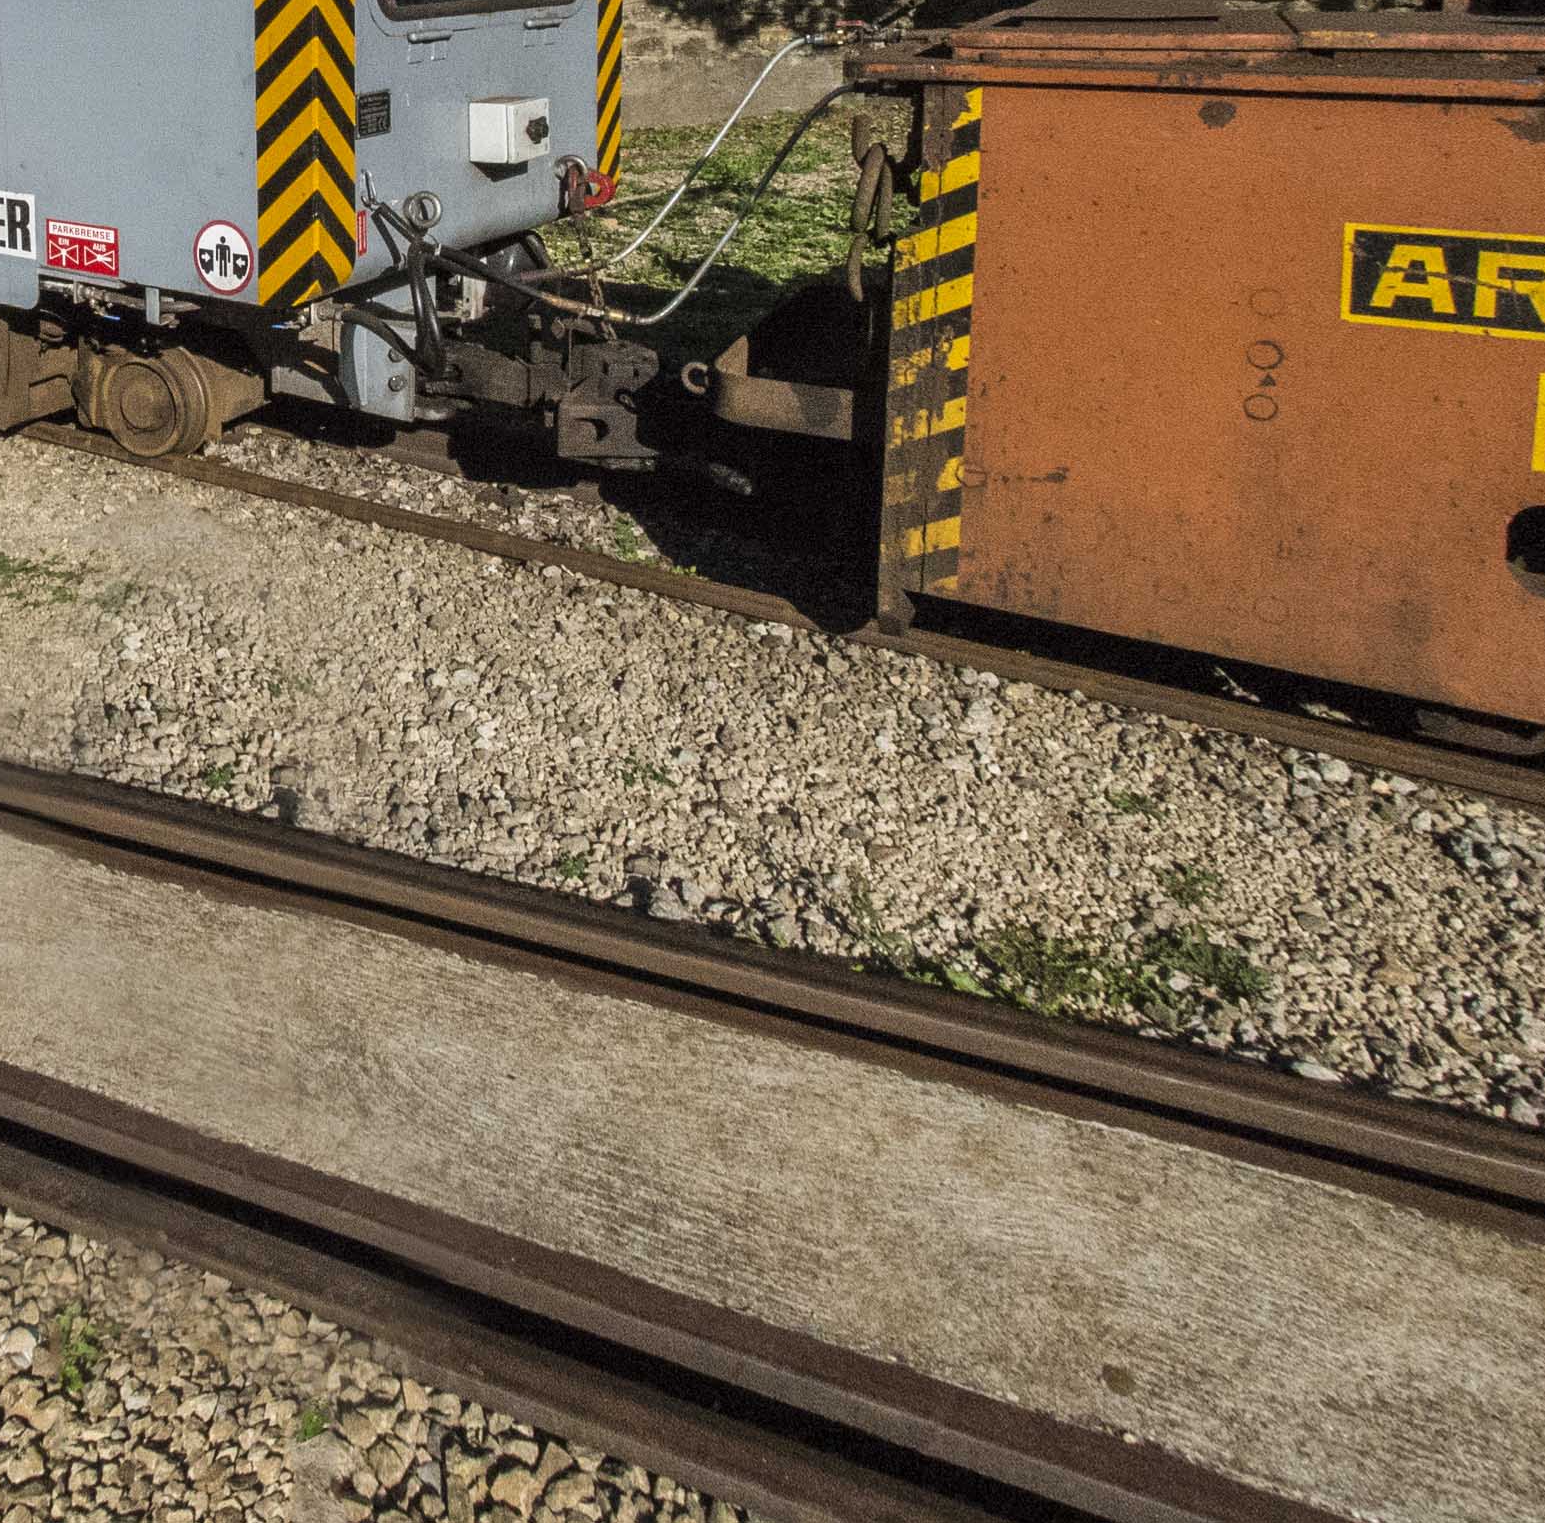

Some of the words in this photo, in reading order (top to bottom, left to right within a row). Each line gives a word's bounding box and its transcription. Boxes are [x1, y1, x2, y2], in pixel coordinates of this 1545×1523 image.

[52, 223, 111, 241] PARKBREMSE
[58, 237, 70, 246] EIN
[92, 242, 107, 253] AUS
